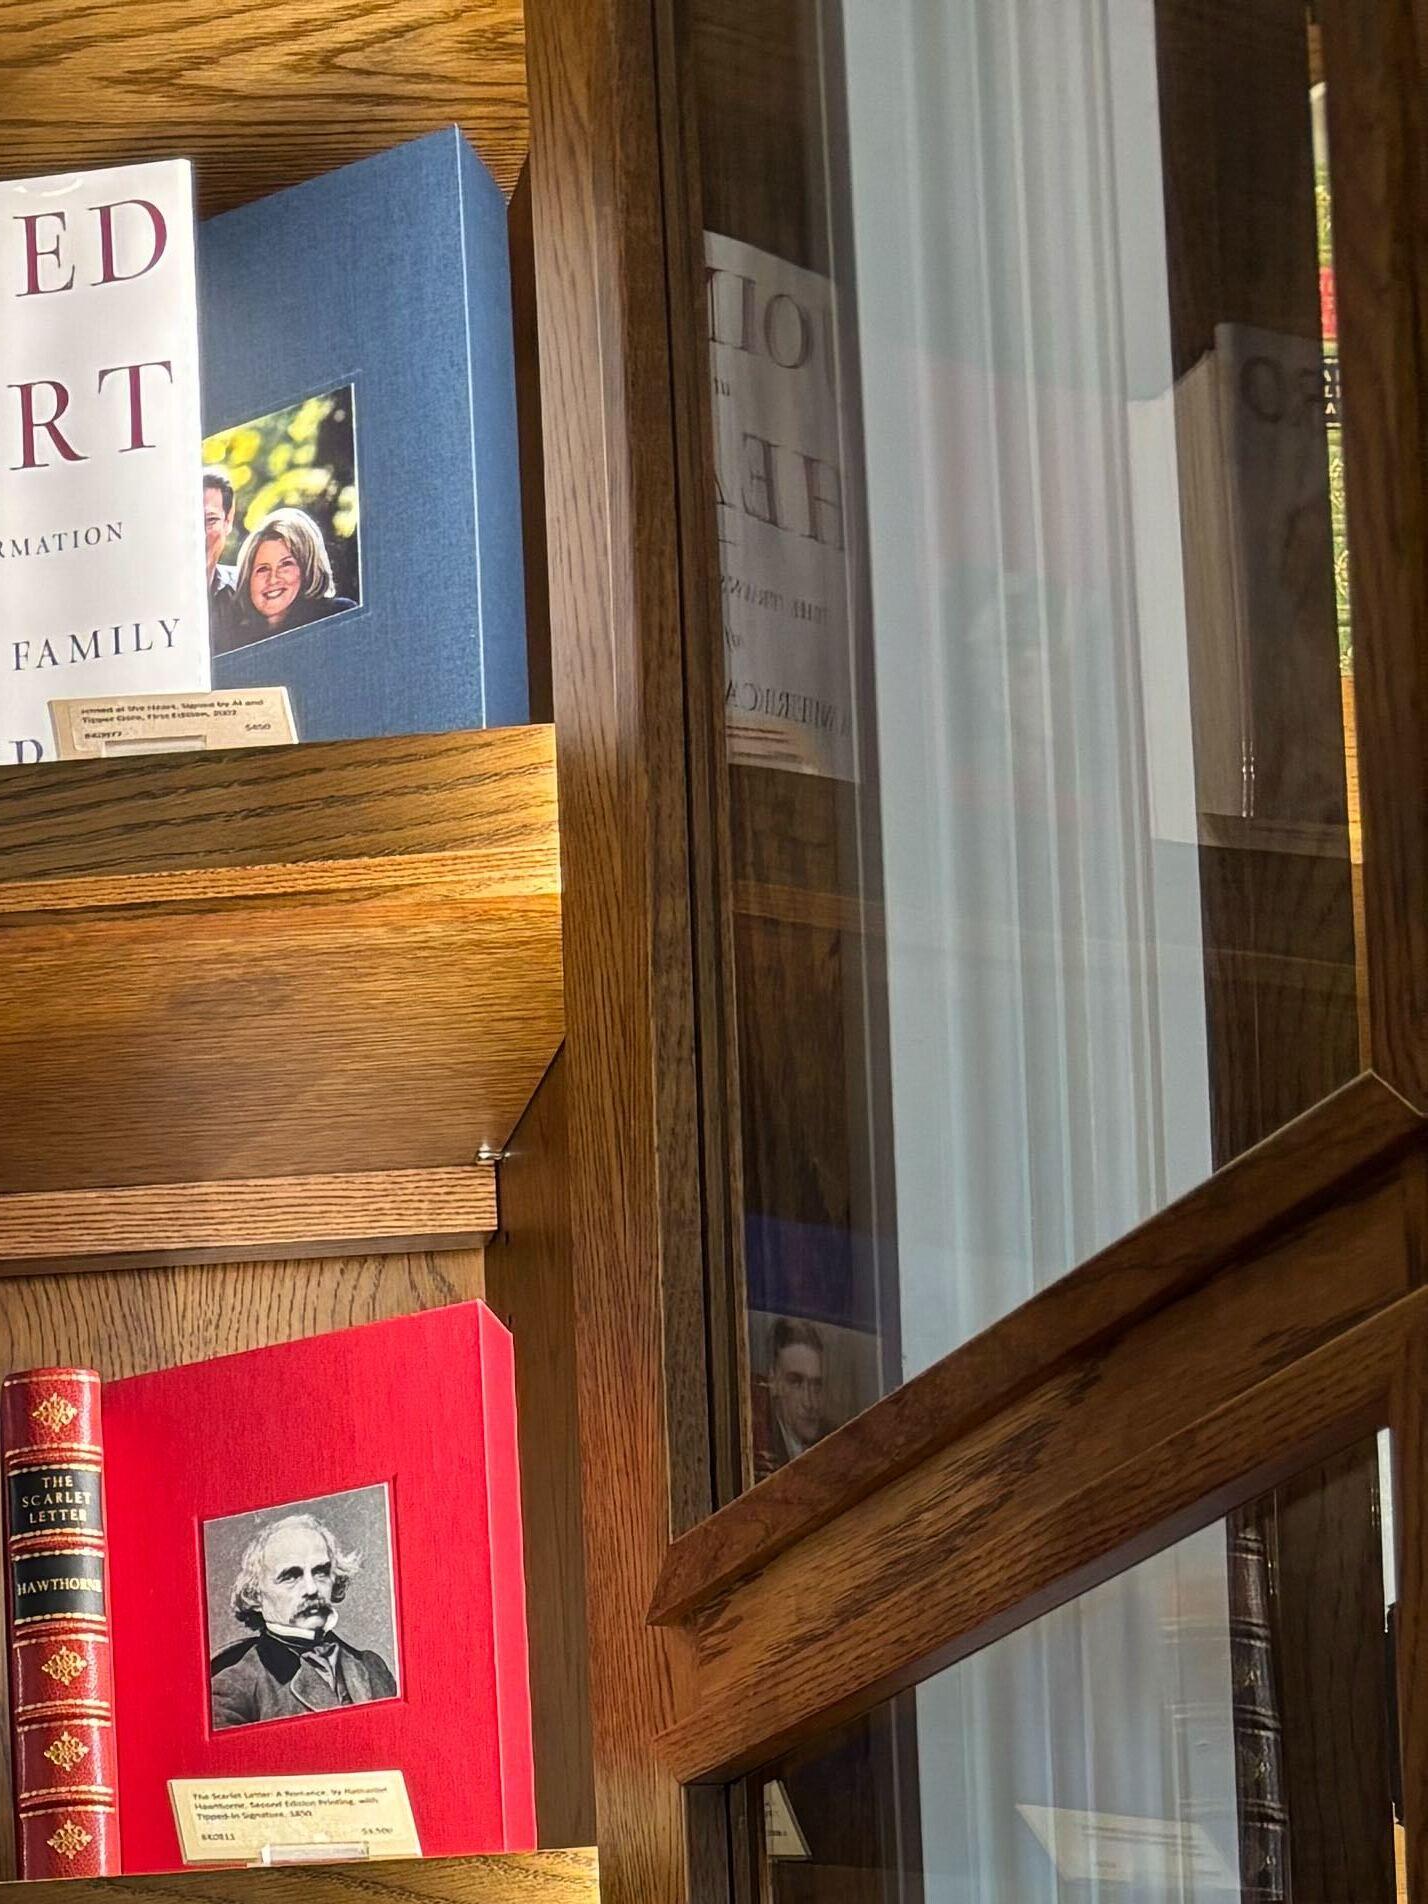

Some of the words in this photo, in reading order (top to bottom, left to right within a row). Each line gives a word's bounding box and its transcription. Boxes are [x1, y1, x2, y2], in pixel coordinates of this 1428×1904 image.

[12, 617, 182, 672] FAMILY
[41, 1474, 73, 1489] THE
[21, 1491, 91, 1508] SCARLET
[28, 1508, 87, 1523] LETTER
[17, 1576, 102, 1596] HAWTHORNE
